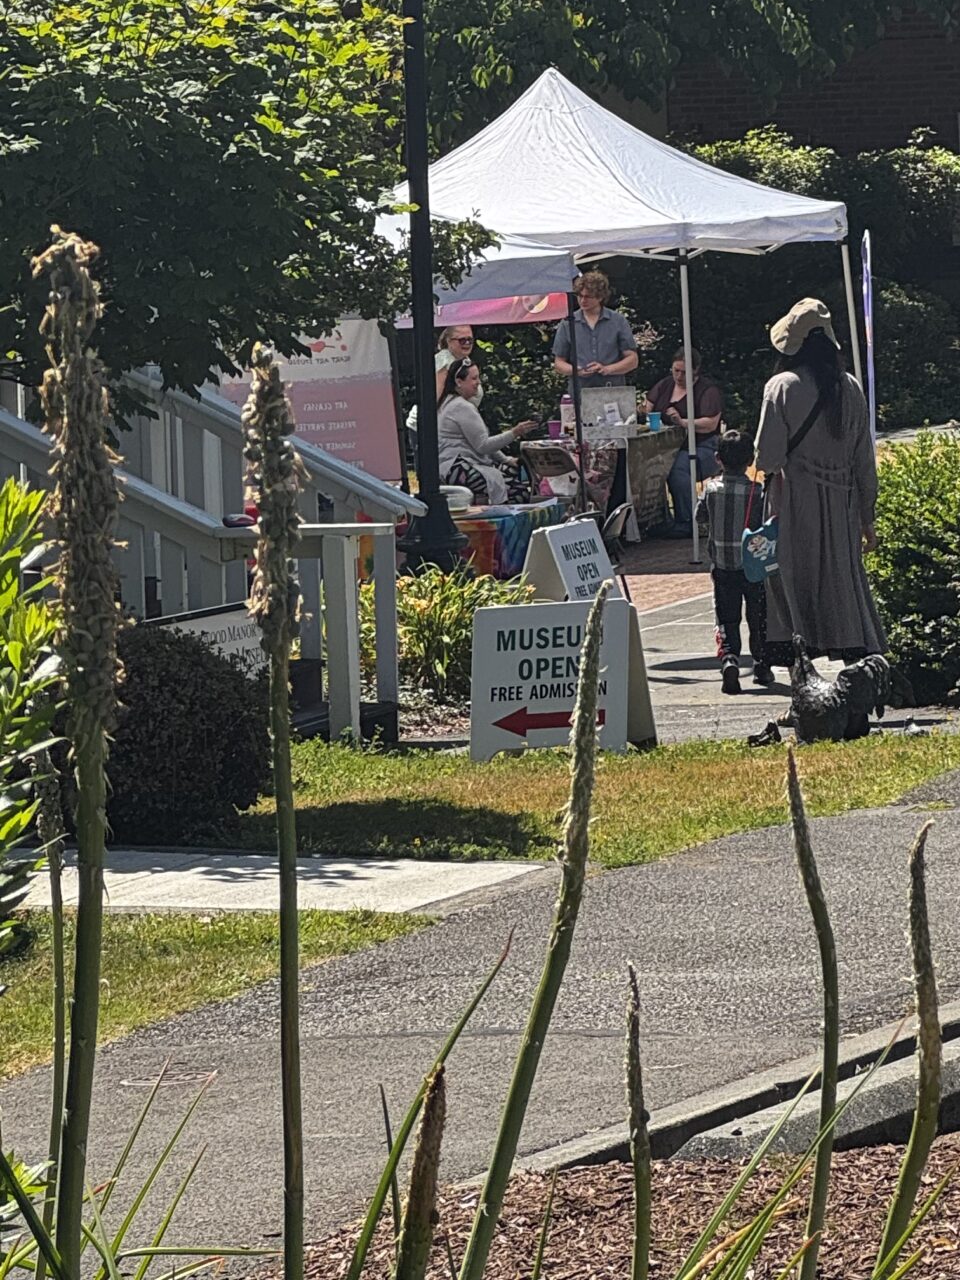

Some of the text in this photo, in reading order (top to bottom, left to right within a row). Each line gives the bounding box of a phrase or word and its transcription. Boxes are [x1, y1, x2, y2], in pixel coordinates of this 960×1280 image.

[561, 538, 599, 561] MUSEUM
[576, 562, 600, 581] OPEN
[227, 624, 257, 642] MANOR
[490, 680, 607, 702] FREE ADMISN
